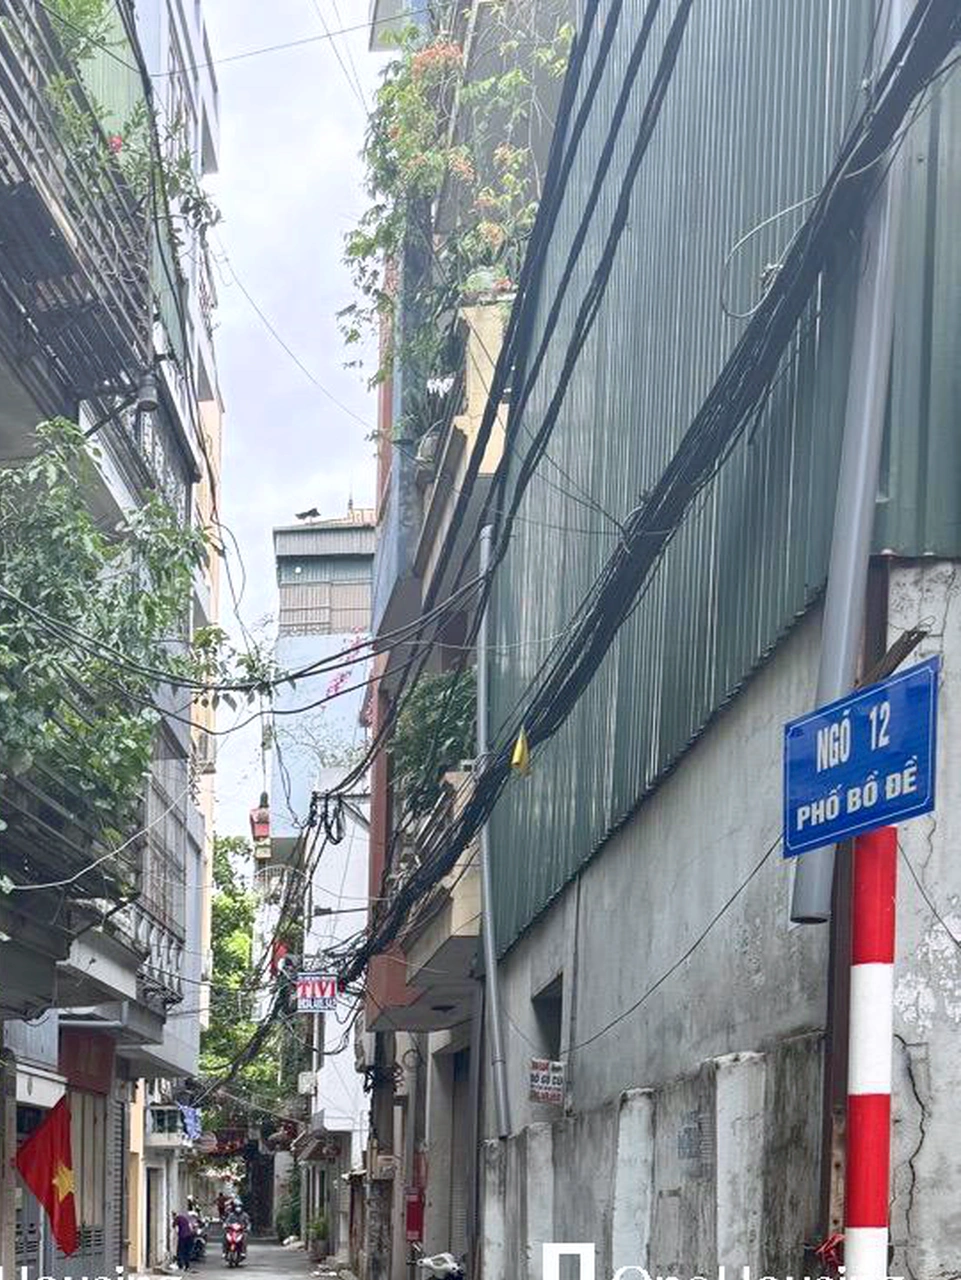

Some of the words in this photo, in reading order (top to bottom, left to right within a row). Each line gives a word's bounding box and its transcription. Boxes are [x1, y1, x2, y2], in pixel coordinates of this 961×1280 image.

[870, 701, 891, 752] 12
[796, 784, 842, 831] PHỐ
[847, 771, 879, 814] BỒ
[885, 755, 918, 800] ĐỀ
[298, 980, 337, 998] TIVI
